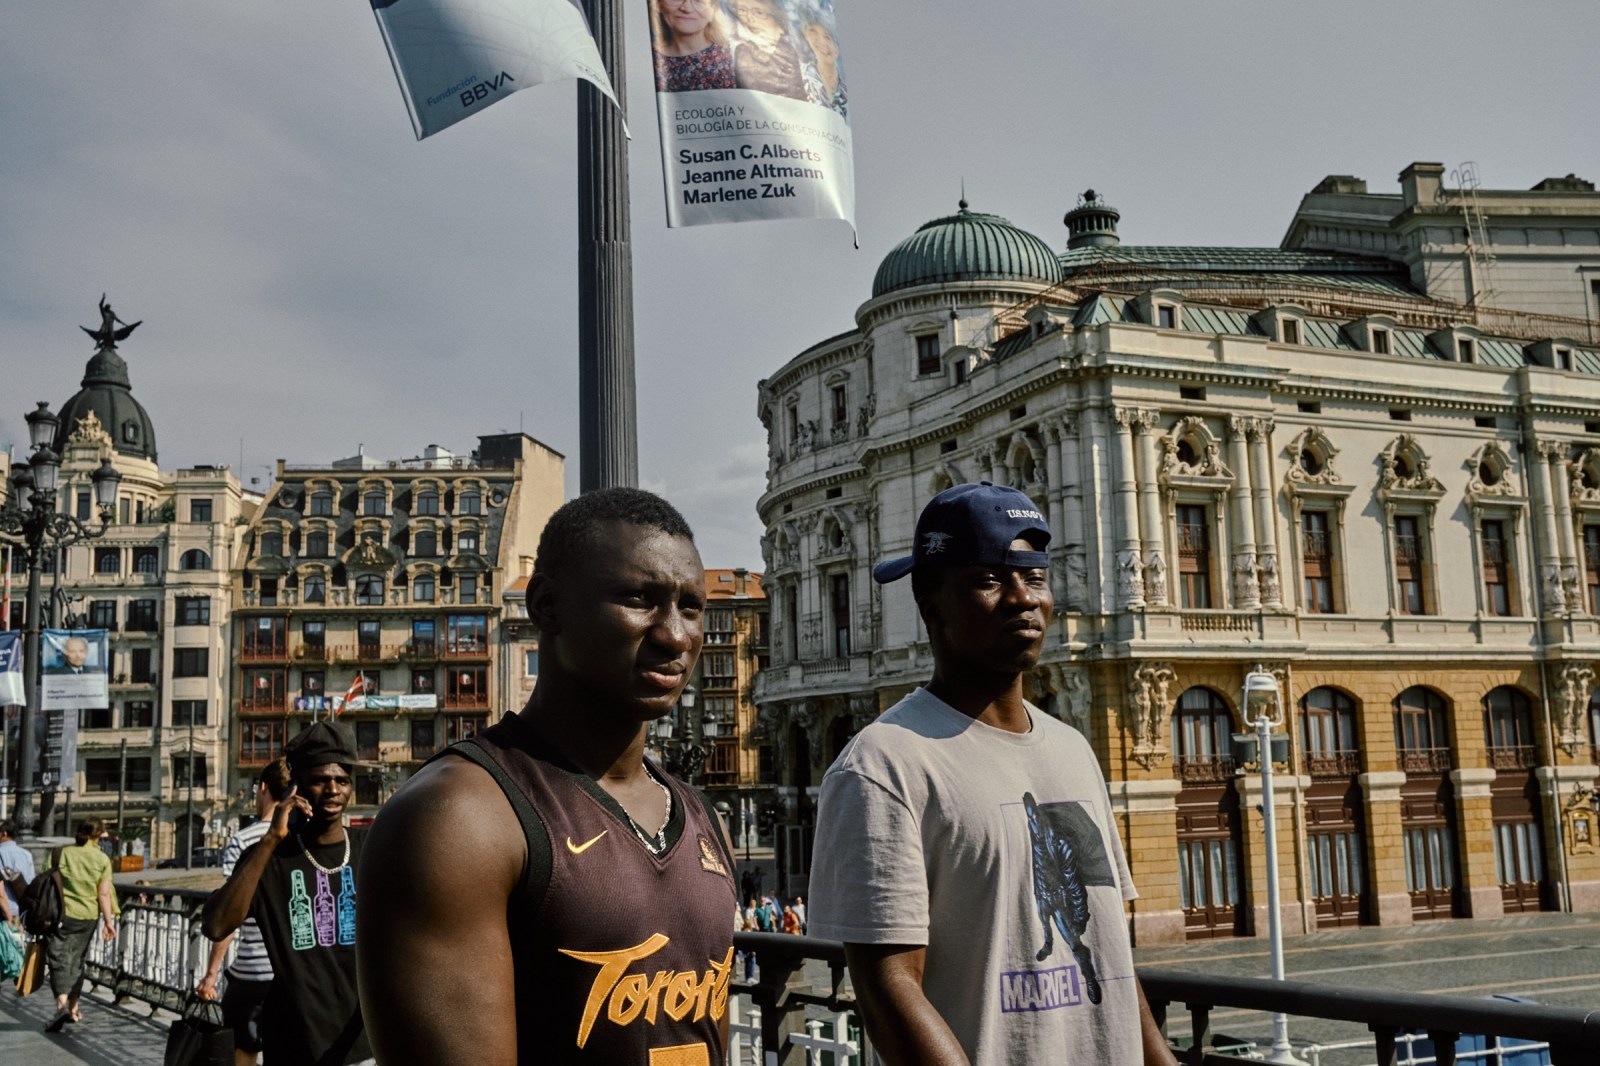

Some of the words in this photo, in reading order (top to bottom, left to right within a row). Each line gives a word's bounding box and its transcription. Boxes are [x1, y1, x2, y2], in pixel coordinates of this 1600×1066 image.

[427, 74, 477, 106] Fundación
[460, 71, 514, 107] BBVA
[675, 106, 735, 120] ECOLOGÍA
[737, 106, 745, 116] Y
[676, 120, 734, 135] BIOLOGÍA
[736, 120, 751, 130] DE
[755, 120, 769, 130] LA
[679, 148, 736, 164] Susan
[739, 145, 758, 160] C.
[760, 144, 822, 162] Alberts
[681, 168, 747, 185] Jeanne
[750, 164, 824, 180] Altmann
[683, 188, 757, 205] Marlene
[760, 183, 796, 199] Zuk
[1002, 968, 1080, 1010] MARVEL
